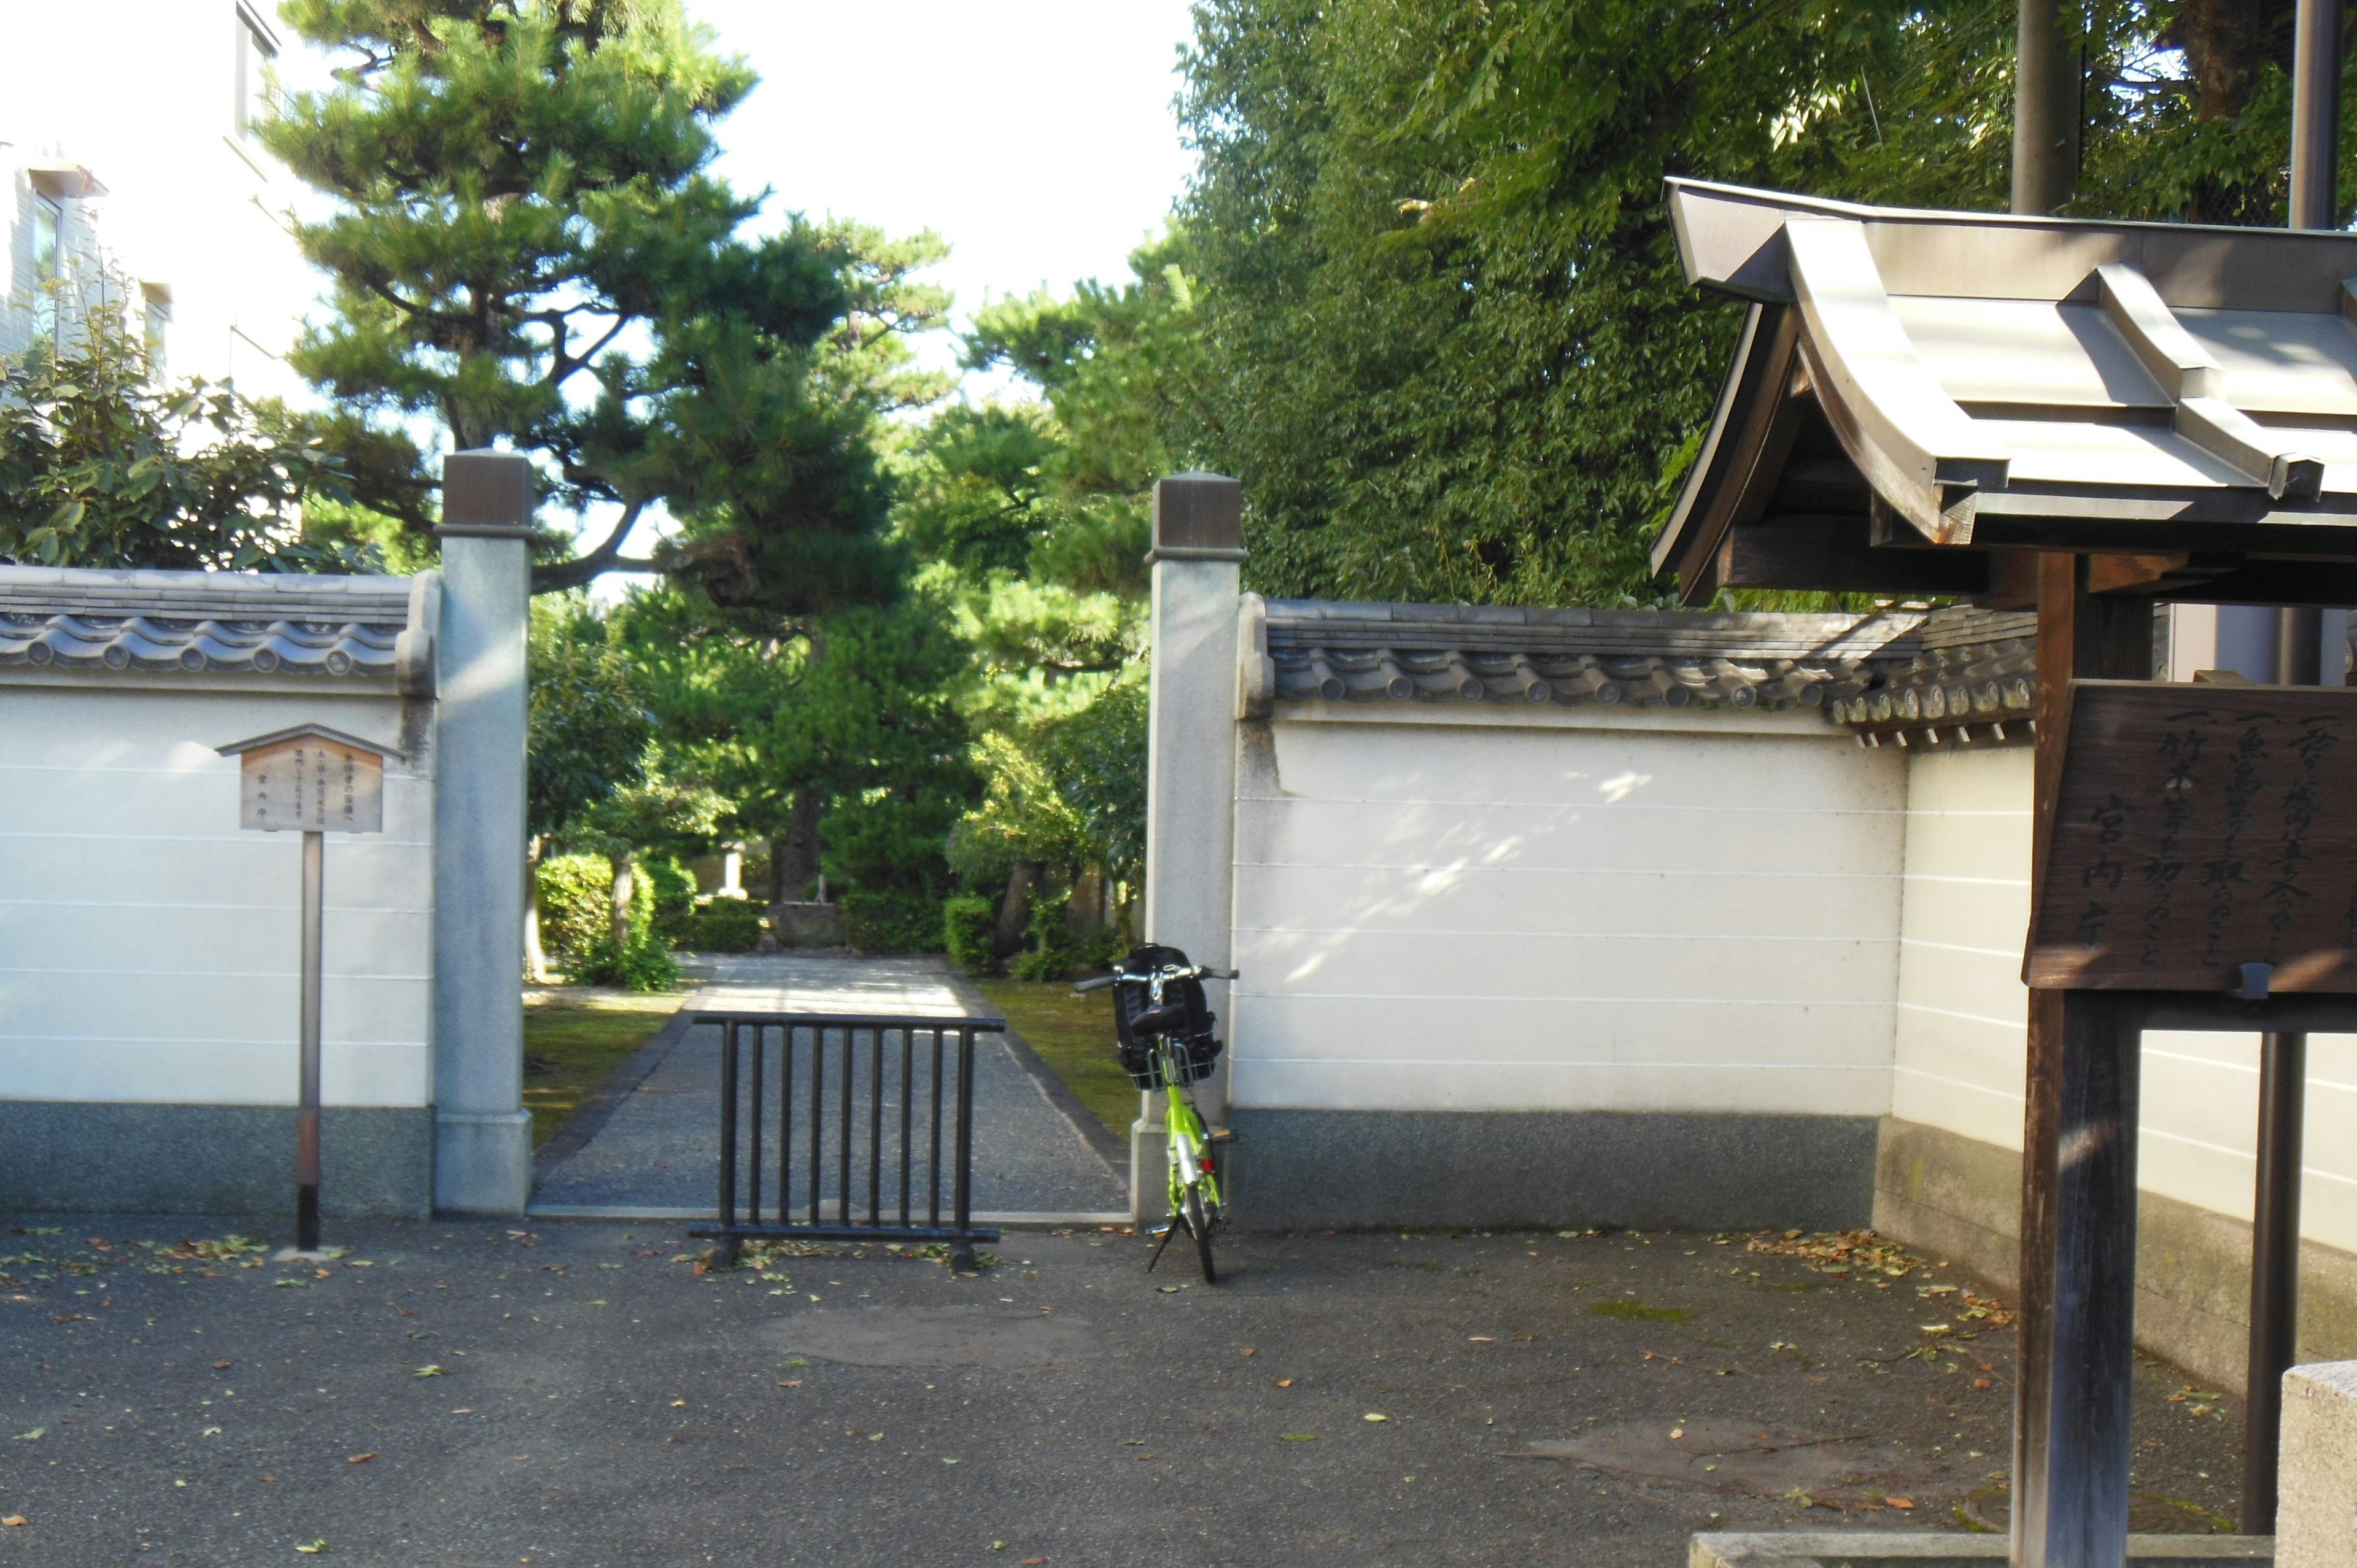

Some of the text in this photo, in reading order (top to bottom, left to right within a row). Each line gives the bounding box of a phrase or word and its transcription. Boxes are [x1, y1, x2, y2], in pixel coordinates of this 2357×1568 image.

[257, 774, 268, 818] 宮内庁
[2075, 792, 2137, 951] 宮内庁
